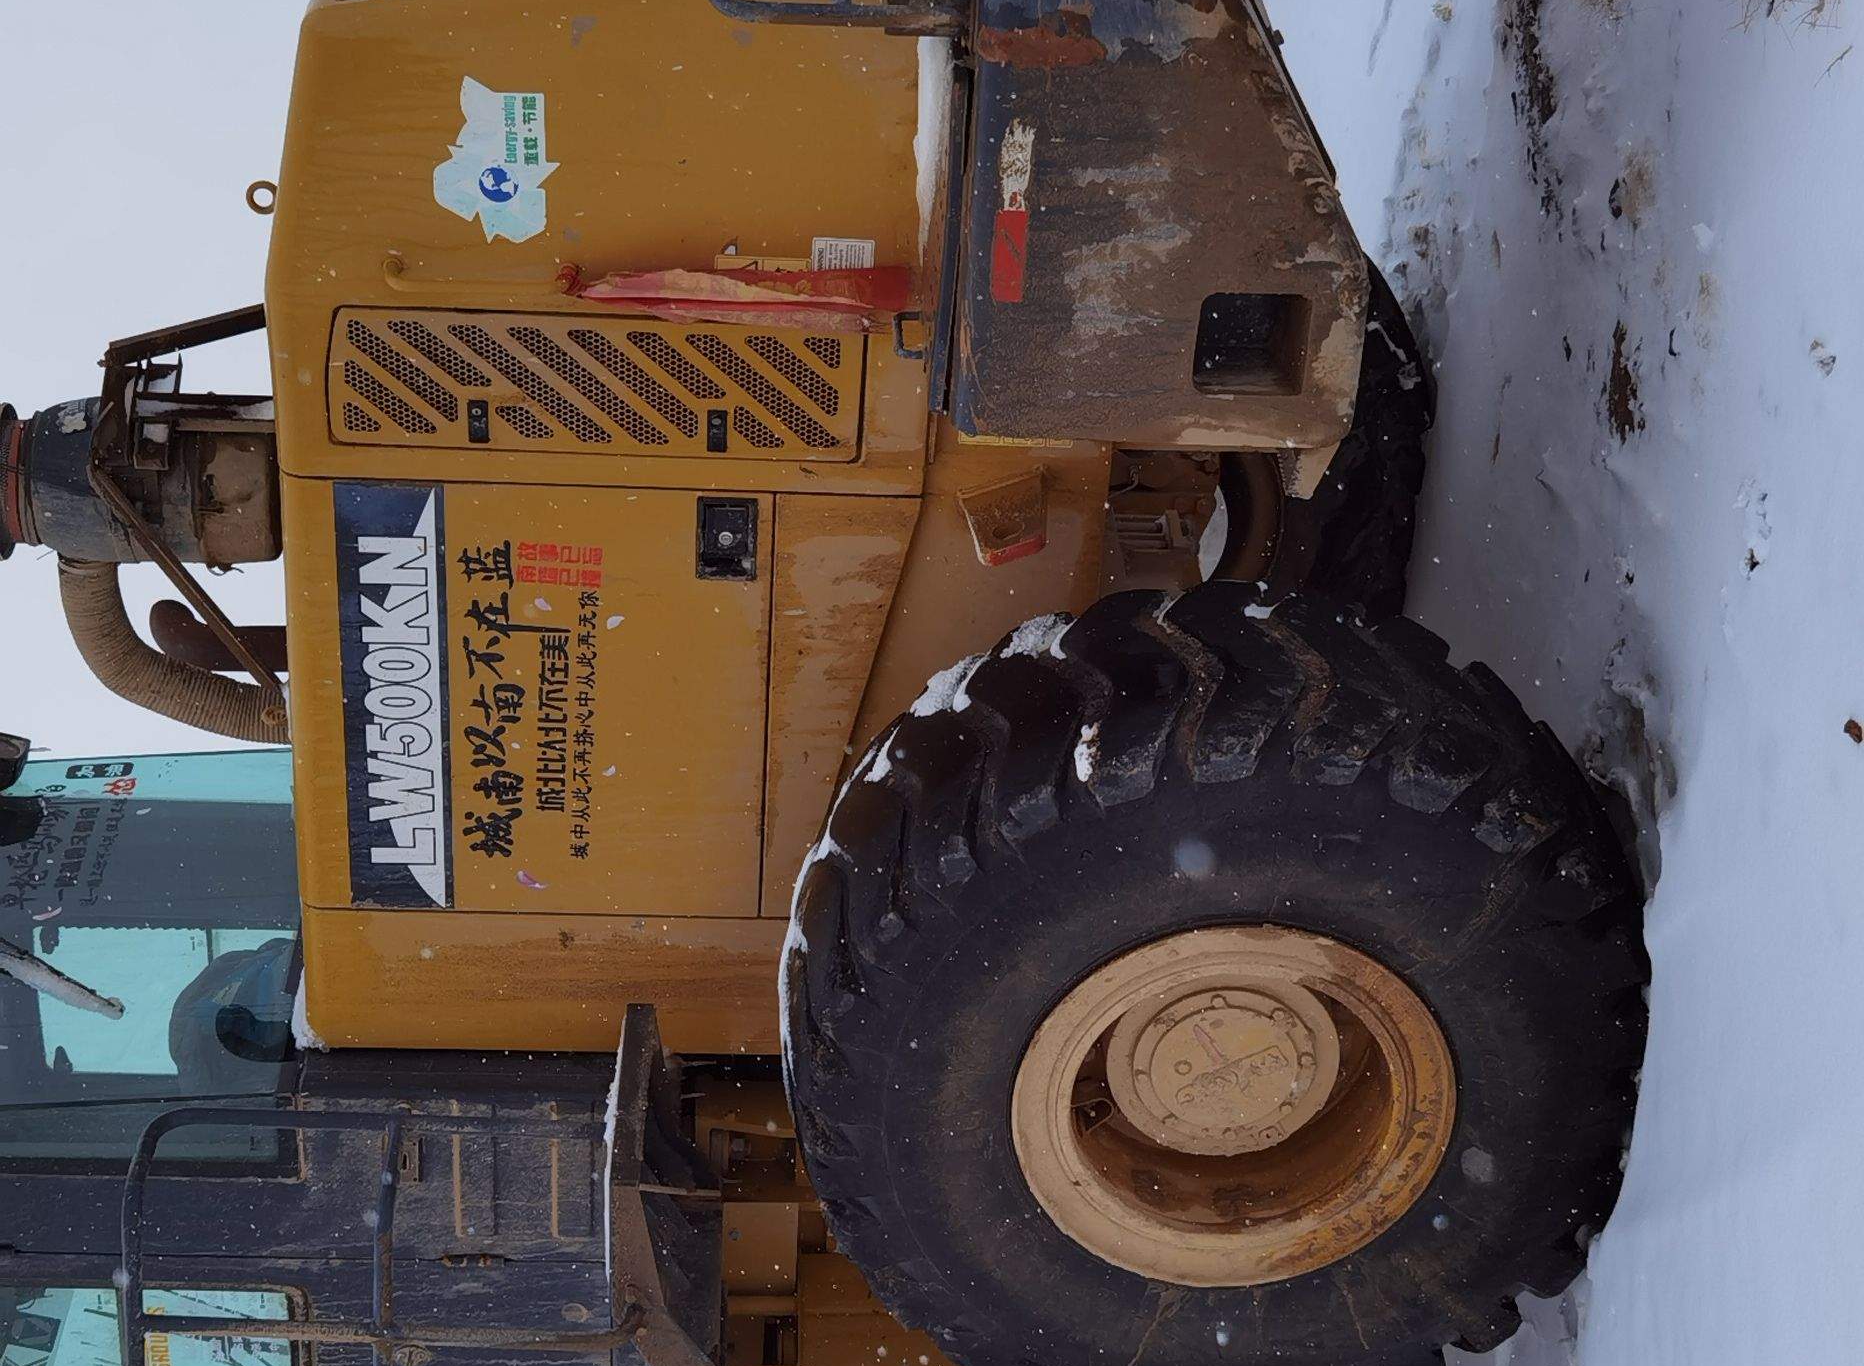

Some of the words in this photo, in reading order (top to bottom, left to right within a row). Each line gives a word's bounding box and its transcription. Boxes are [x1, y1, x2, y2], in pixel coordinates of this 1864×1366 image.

[502, 95, 518, 164] Energy-saving
[357, 535, 436, 865] LW500KN
[456, 539, 571, 858] 城南以南不在蓝
[535, 634, 570, 813] 城北以北不在美
